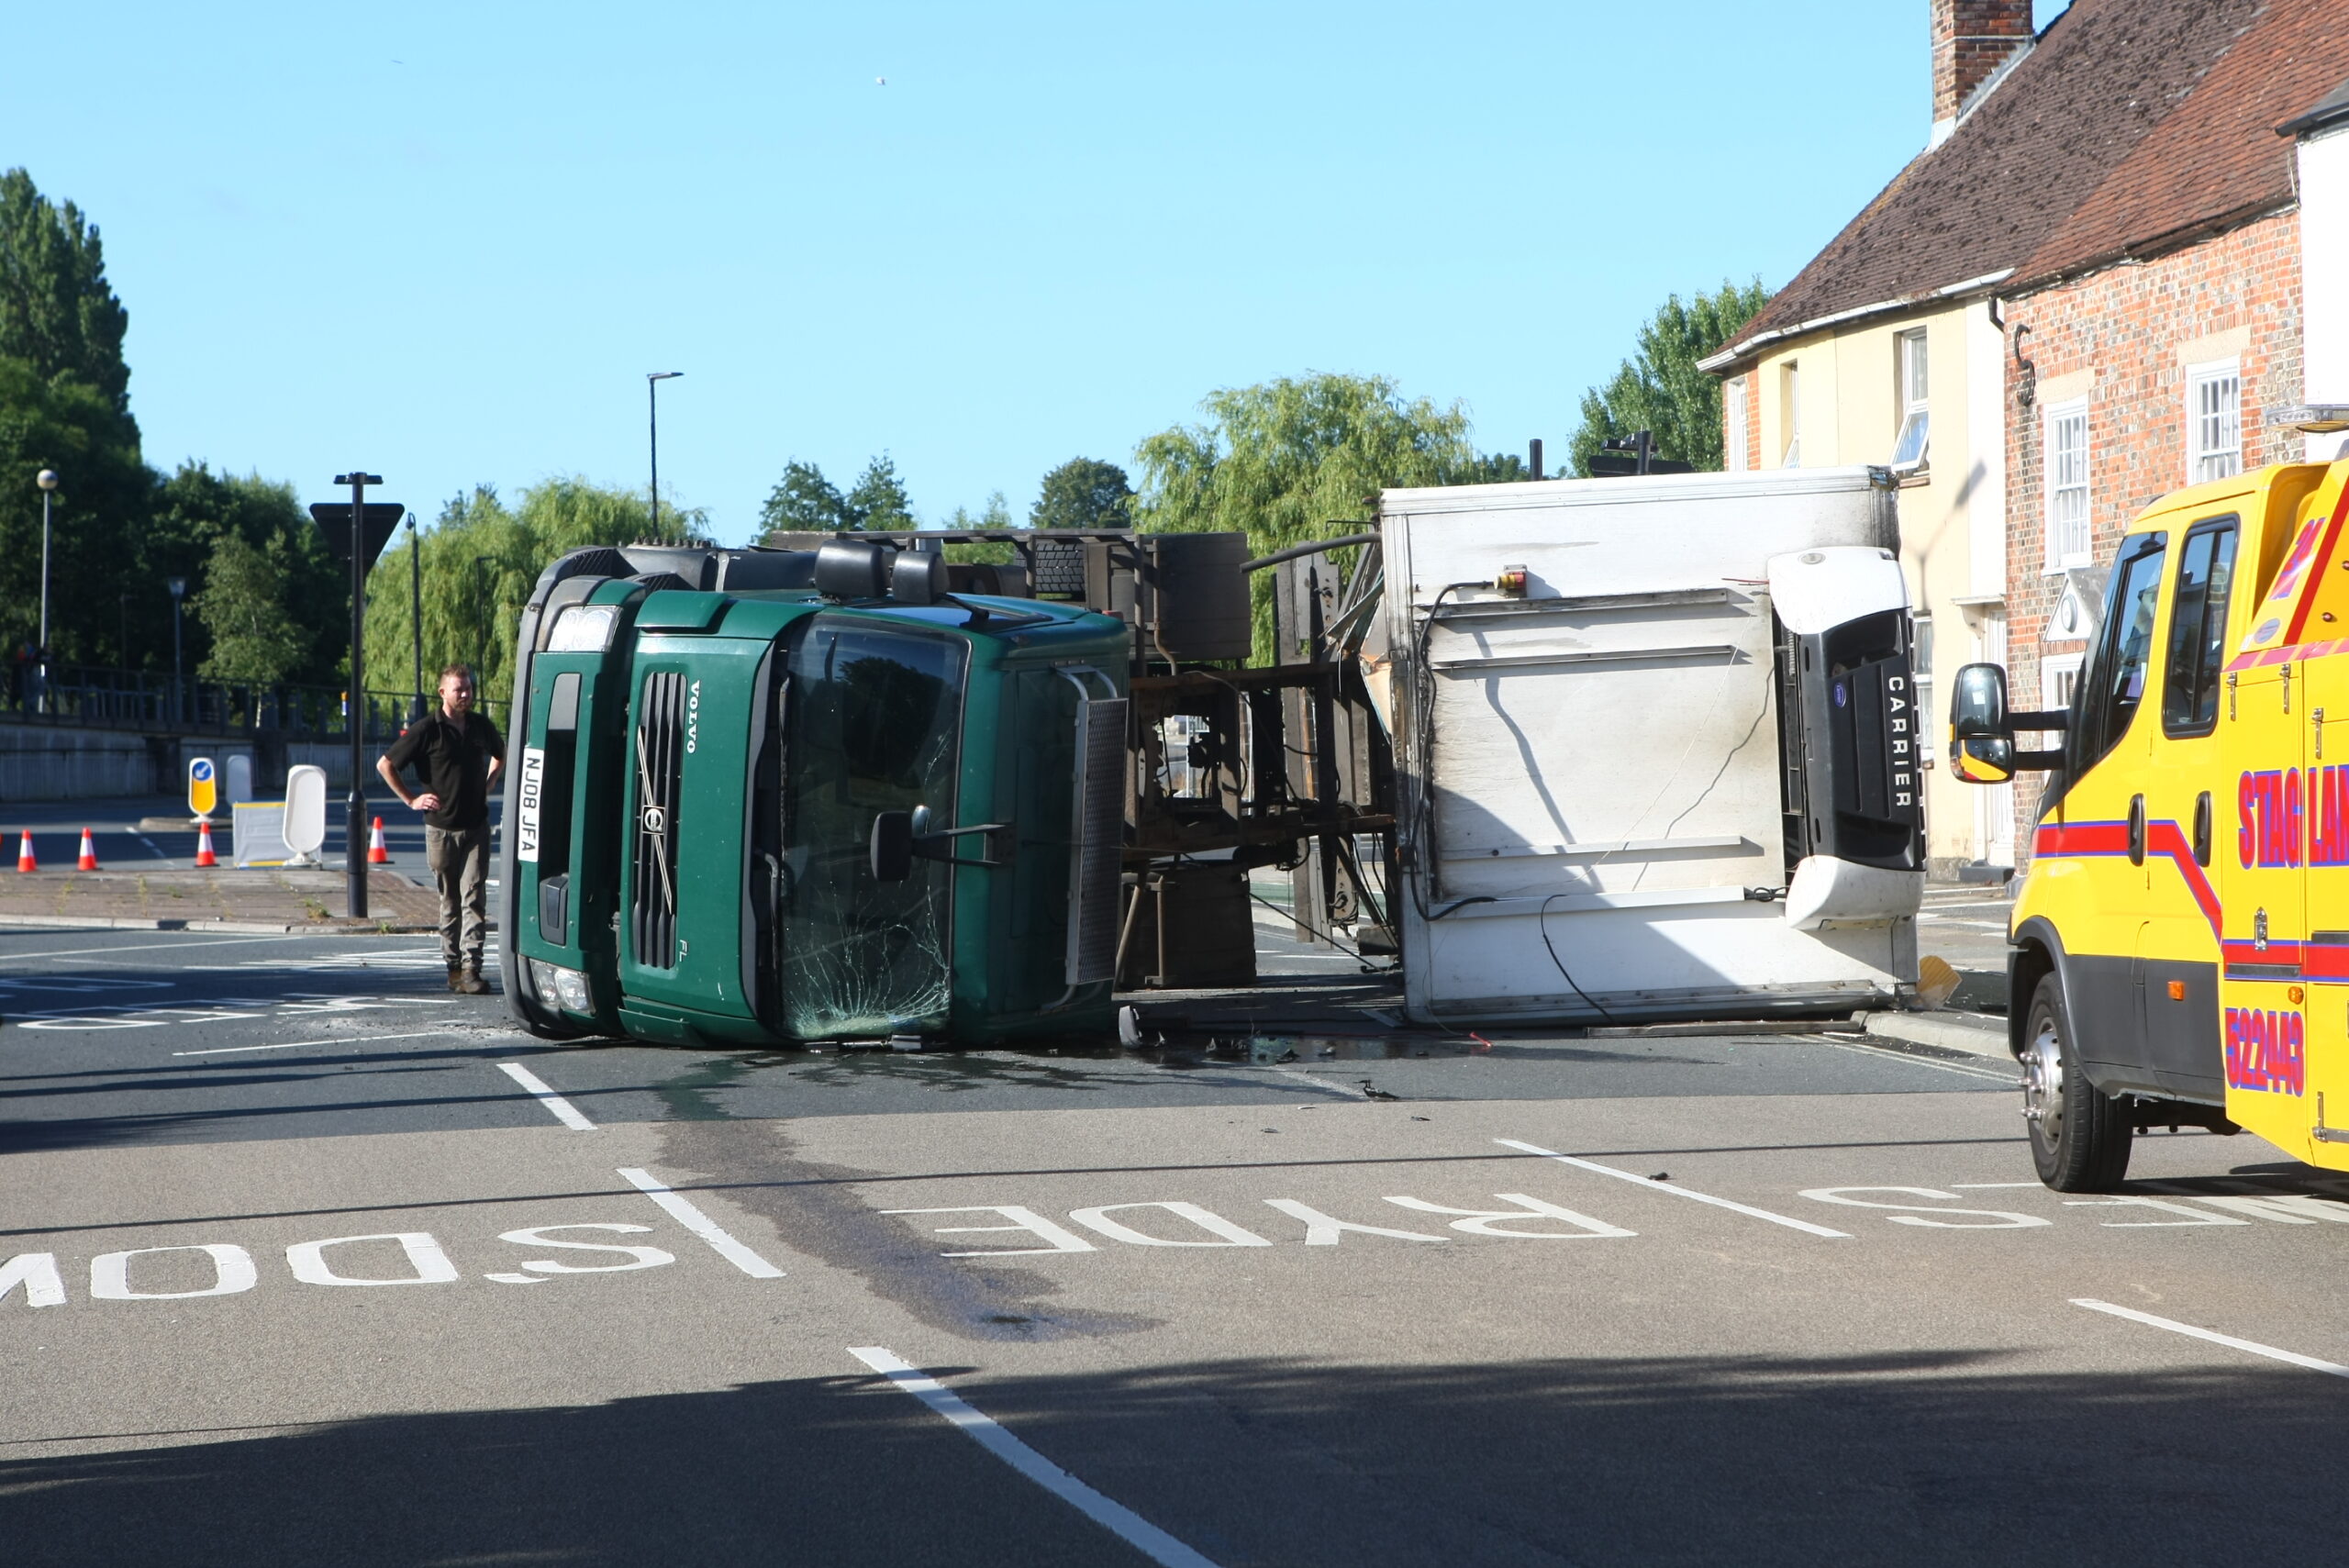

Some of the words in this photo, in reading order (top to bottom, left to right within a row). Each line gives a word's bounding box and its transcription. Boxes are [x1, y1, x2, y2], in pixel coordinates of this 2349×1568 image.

[687, 680, 700, 753] VOLVO
[1888, 676, 1911, 806] CARRIER
[523, 757, 540, 809] NJ08
[521, 815, 537, 851] JFA
[2238, 767, 2304, 869] STAG
[680, 939, 687, 962] FL
[2224, 1006, 2304, 1097] 522443
[880, 1193, 1639, 1258] RYDE
